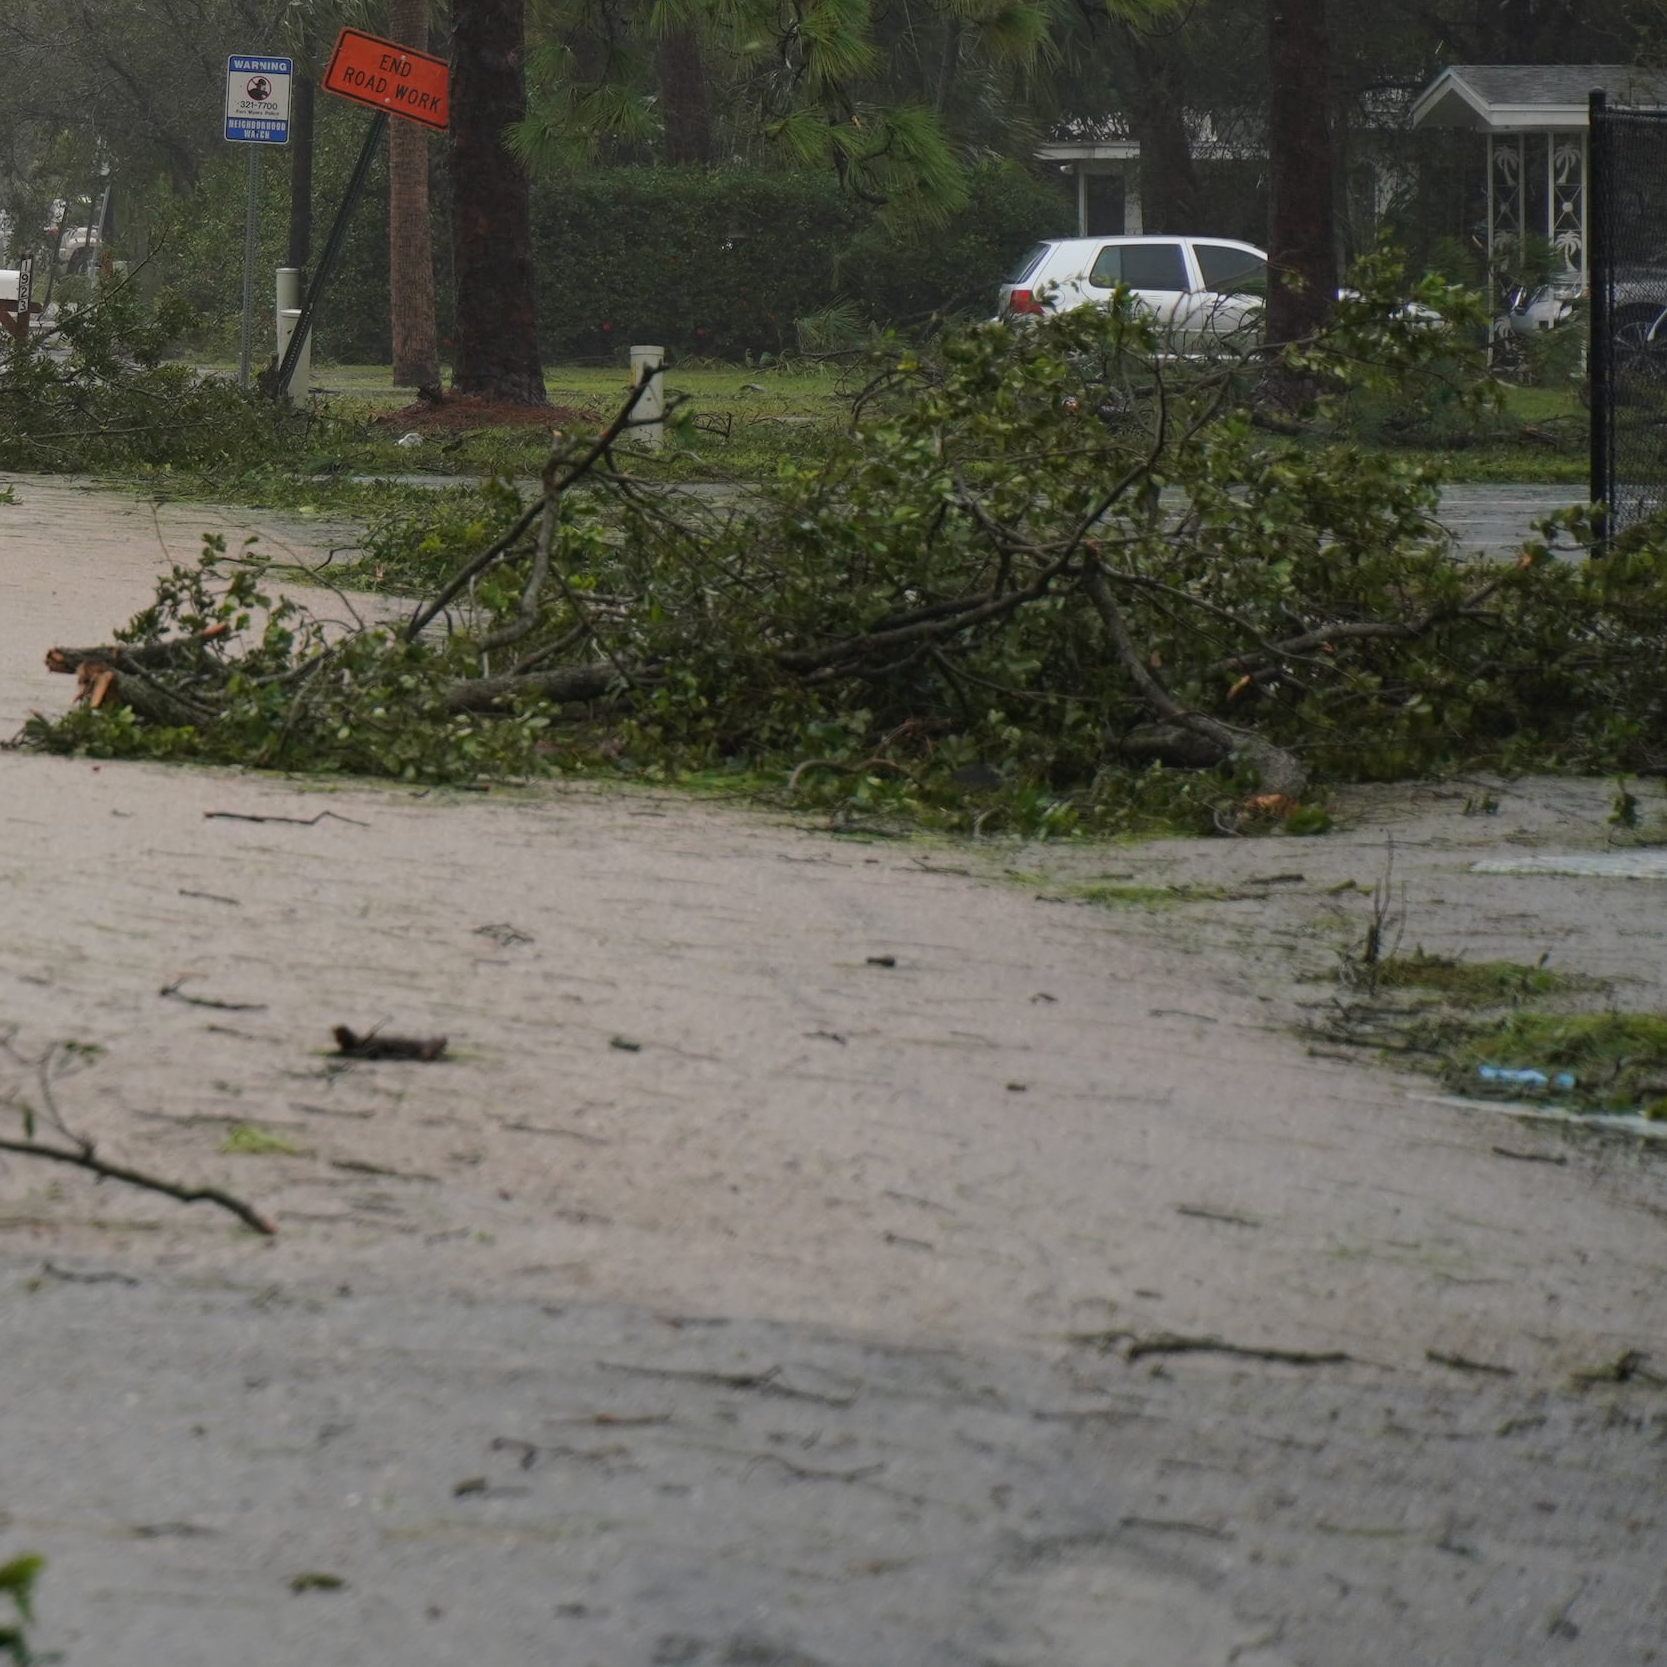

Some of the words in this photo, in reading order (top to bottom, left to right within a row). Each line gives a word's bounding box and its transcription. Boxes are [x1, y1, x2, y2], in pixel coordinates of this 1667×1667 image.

[233, 60, 287, 71] WARNING
[379, 54, 412, 77] END
[343, 66, 387, 93] ROAD
[395, 83, 441, 113] WORK
[240, 101, 278, 110] 321-7700
[228, 119, 286, 131] NEIGHBORHOOD
[244, 129, 270, 139] WATCH
[20, 260, 29, 311] 1923
